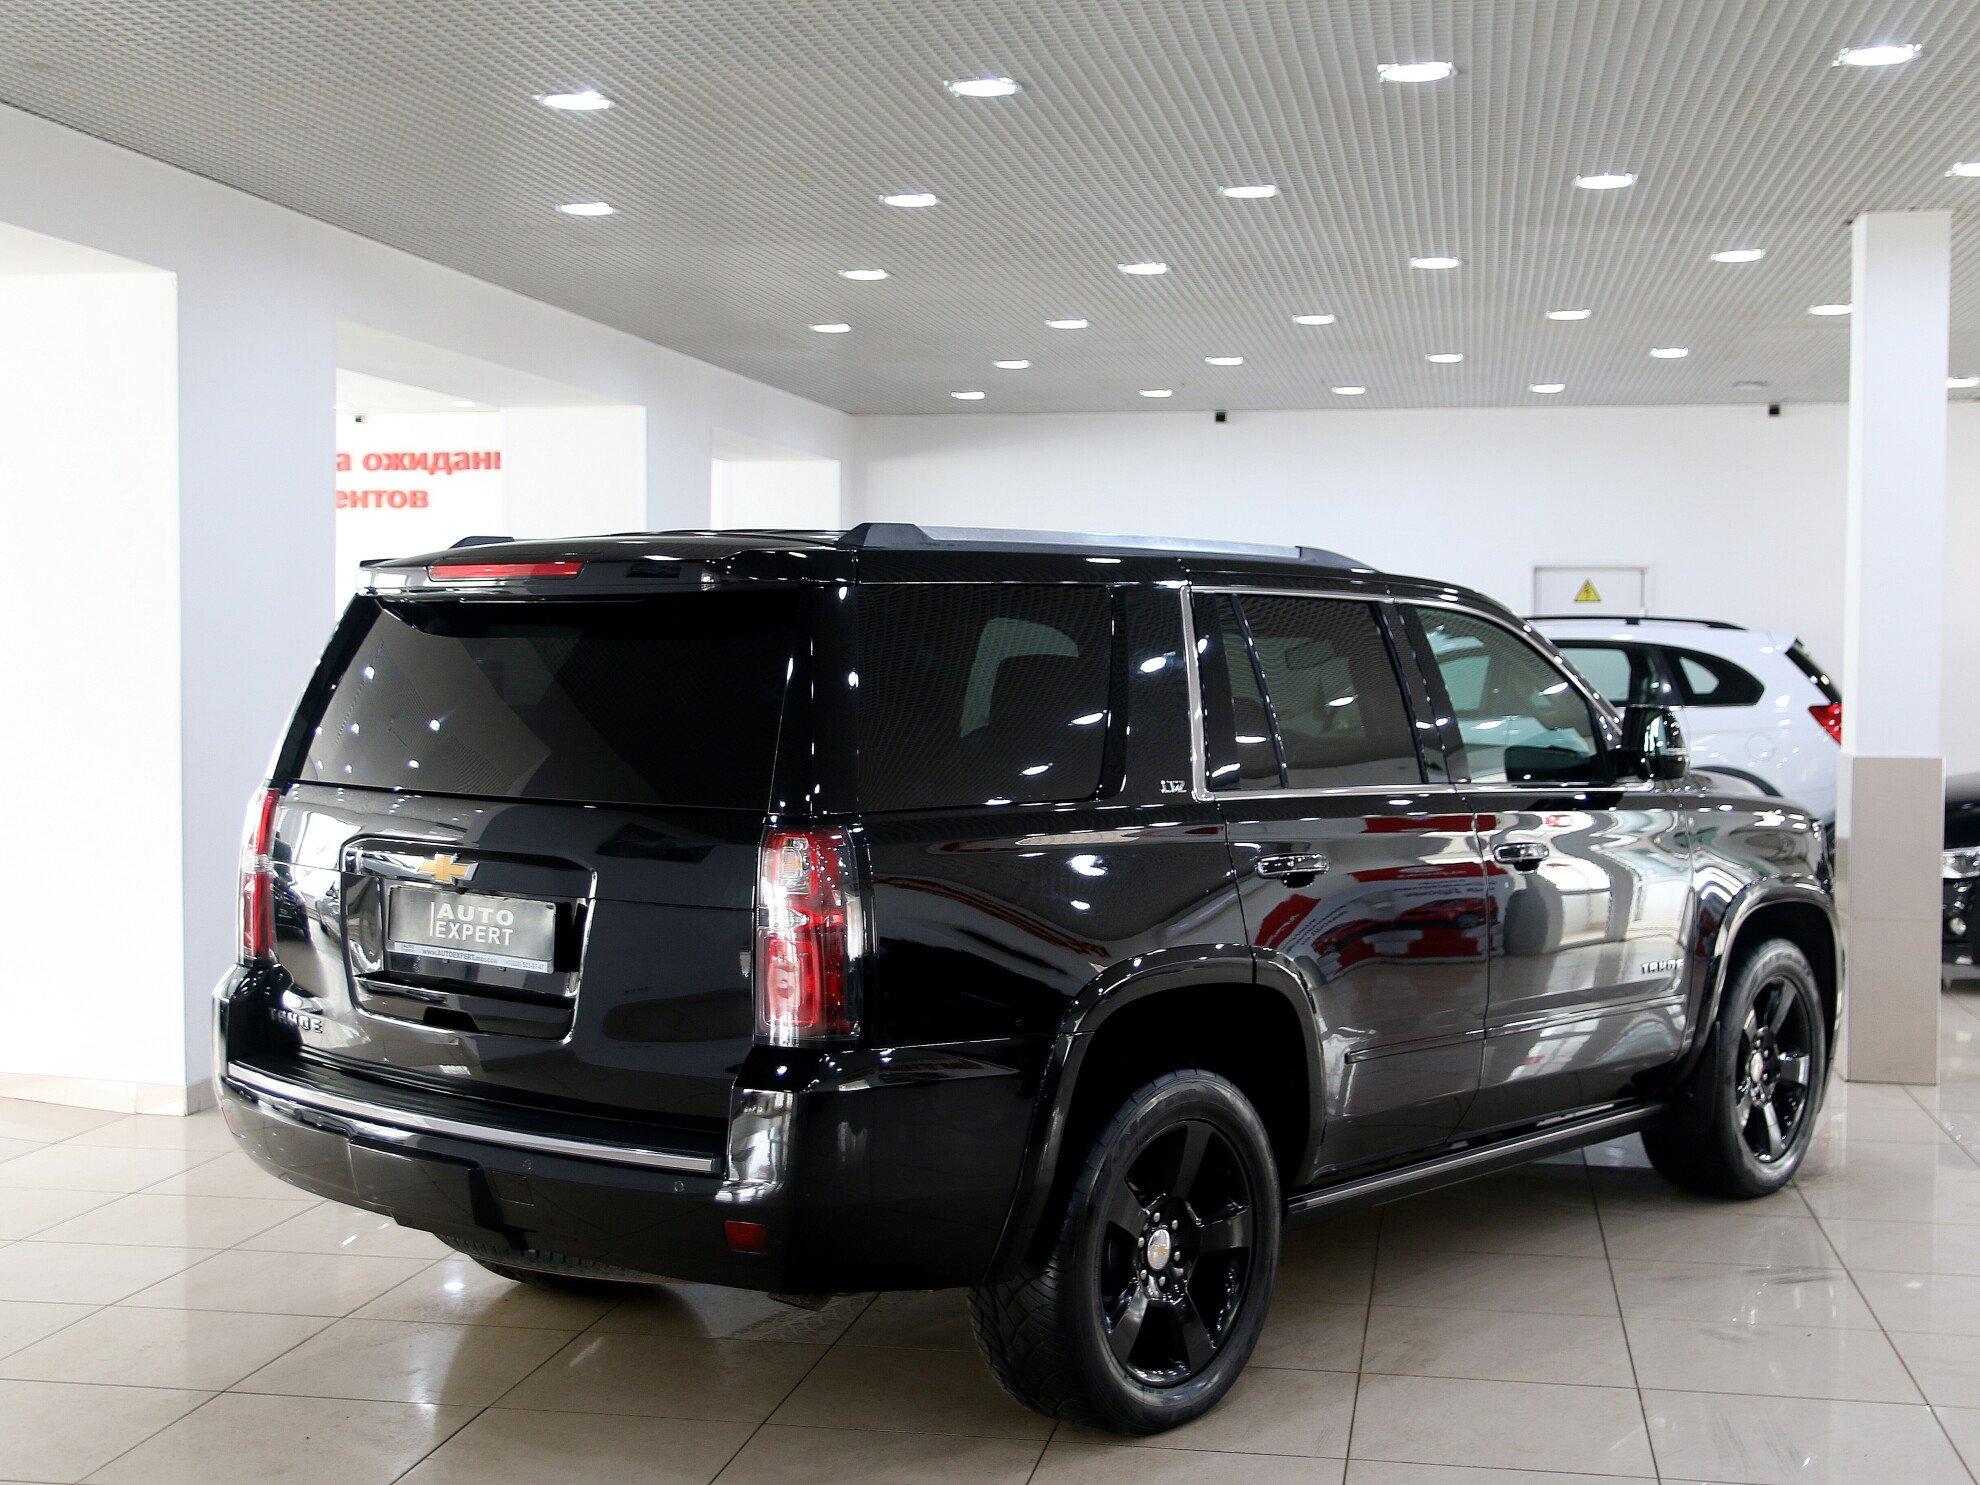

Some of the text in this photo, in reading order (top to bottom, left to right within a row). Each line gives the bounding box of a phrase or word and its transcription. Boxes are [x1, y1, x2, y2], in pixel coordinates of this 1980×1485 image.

[336, 453, 351, 471] а
[1160, 779, 1187, 793] LTZ
[437, 902, 514, 927] AUTO
[435, 920, 514, 946] EXPERT
[1641, 958, 1685, 974] TAHOE
